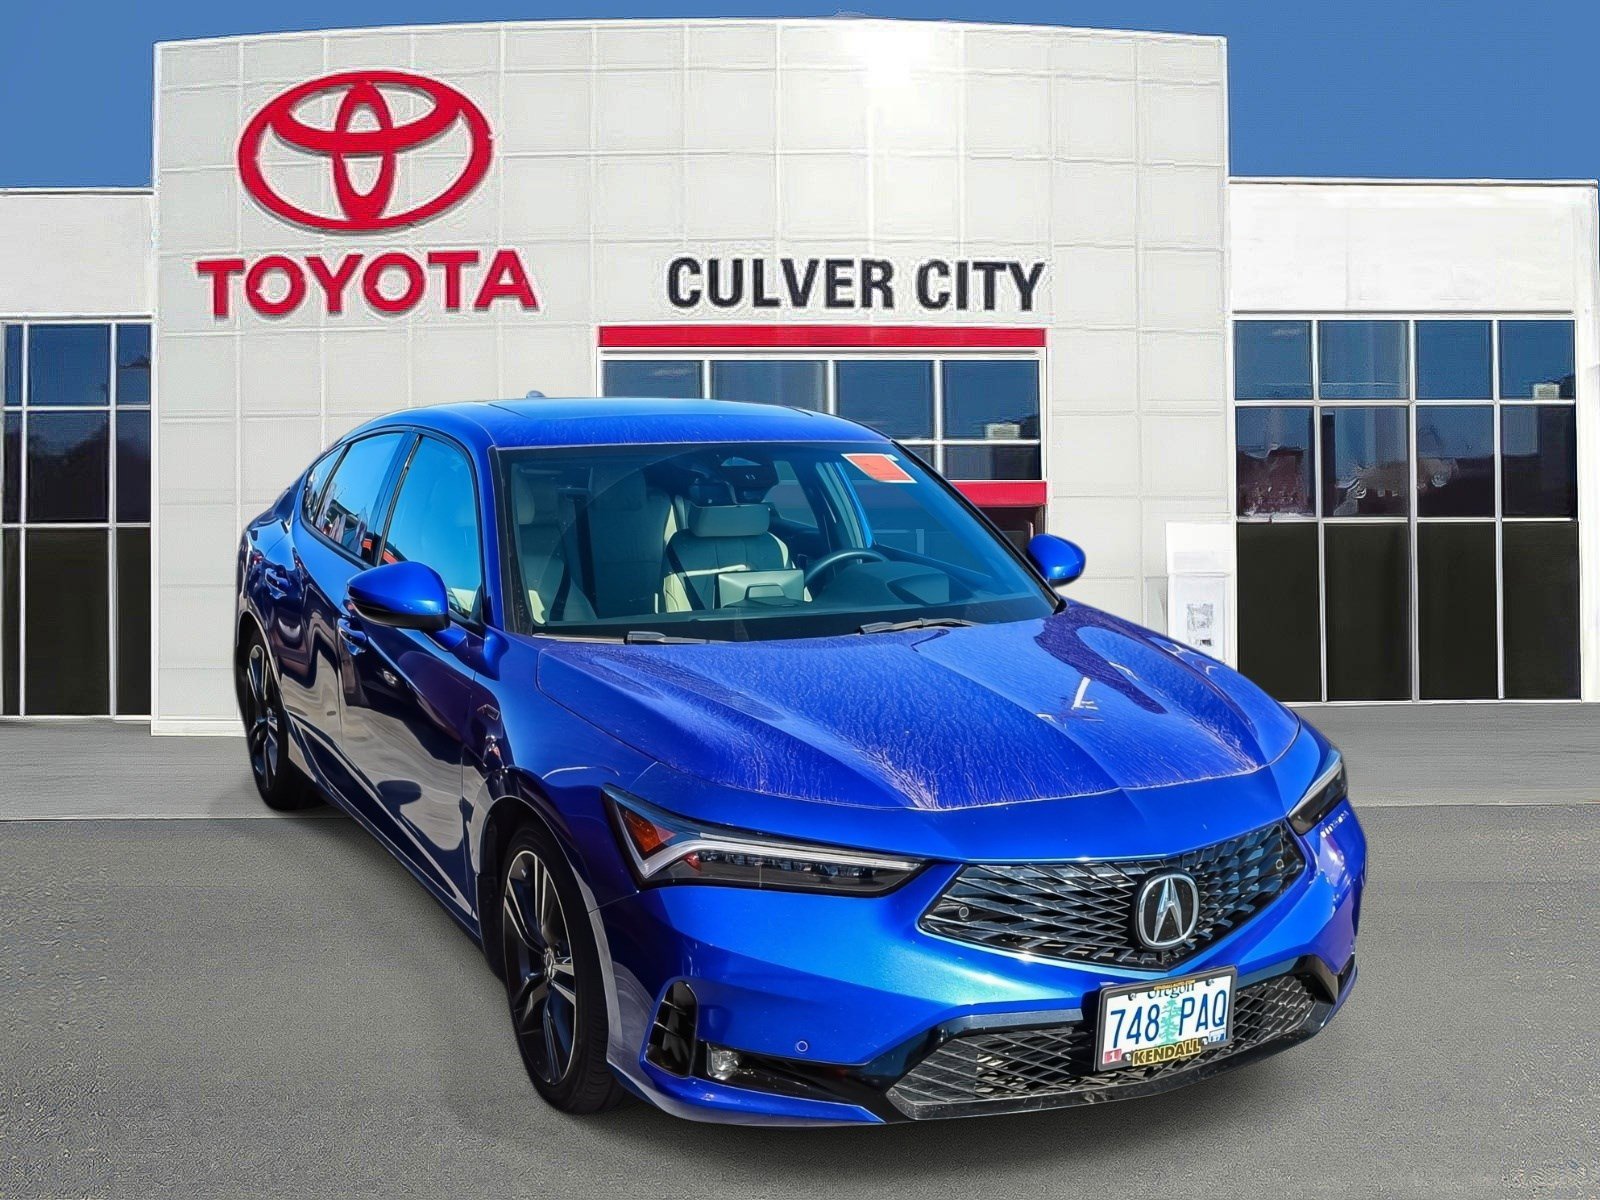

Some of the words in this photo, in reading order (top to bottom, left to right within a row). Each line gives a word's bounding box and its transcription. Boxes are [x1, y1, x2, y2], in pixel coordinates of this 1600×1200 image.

[196, 249, 540, 318] TOYOTA
[667, 257, 895, 309] CULVER
[915, 259, 1046, 311] CITY
[1147, 981, 1195, 999] Oregon
[1110, 1004, 1160, 1049] 748
[1178, 989, 1227, 1036] PAQ
[1133, 1039, 1201, 1065] KENDALL
